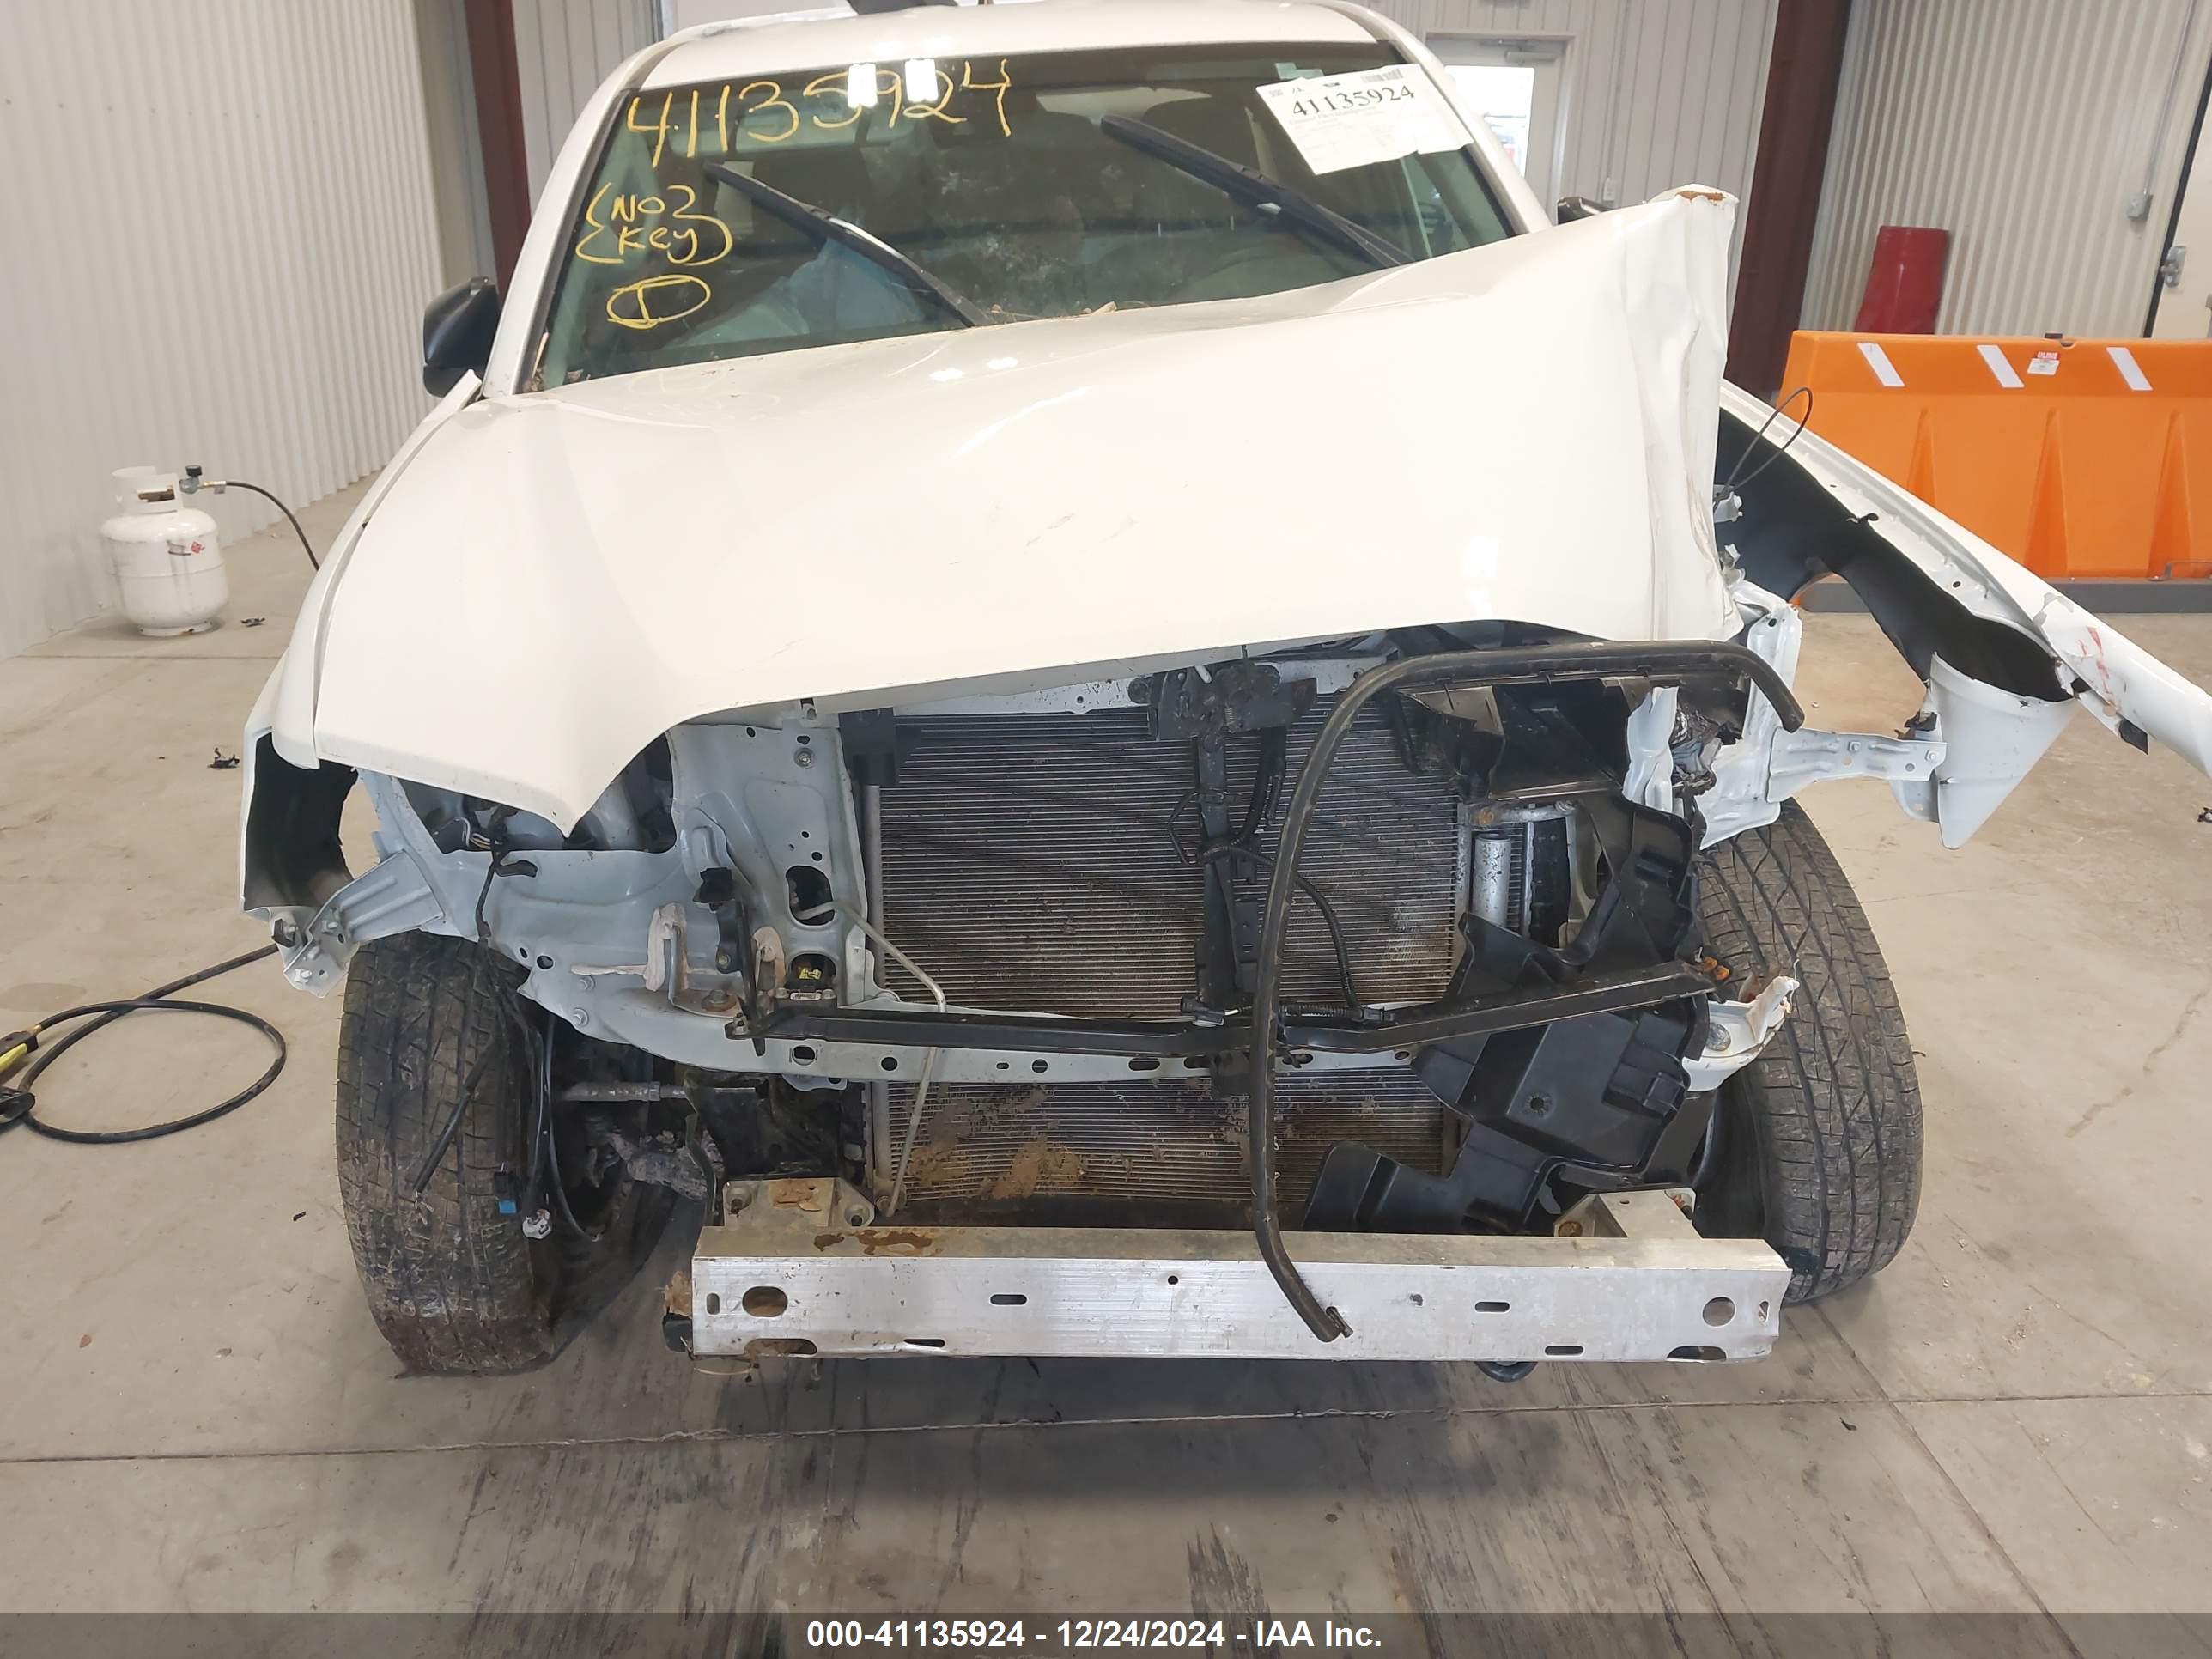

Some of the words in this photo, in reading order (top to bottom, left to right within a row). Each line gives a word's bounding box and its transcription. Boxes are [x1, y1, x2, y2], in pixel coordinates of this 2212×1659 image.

[627, 58, 1012, 168] 41135924
[1292, 84, 1415, 116] 41135924
[611, 193, 666, 222] NO
